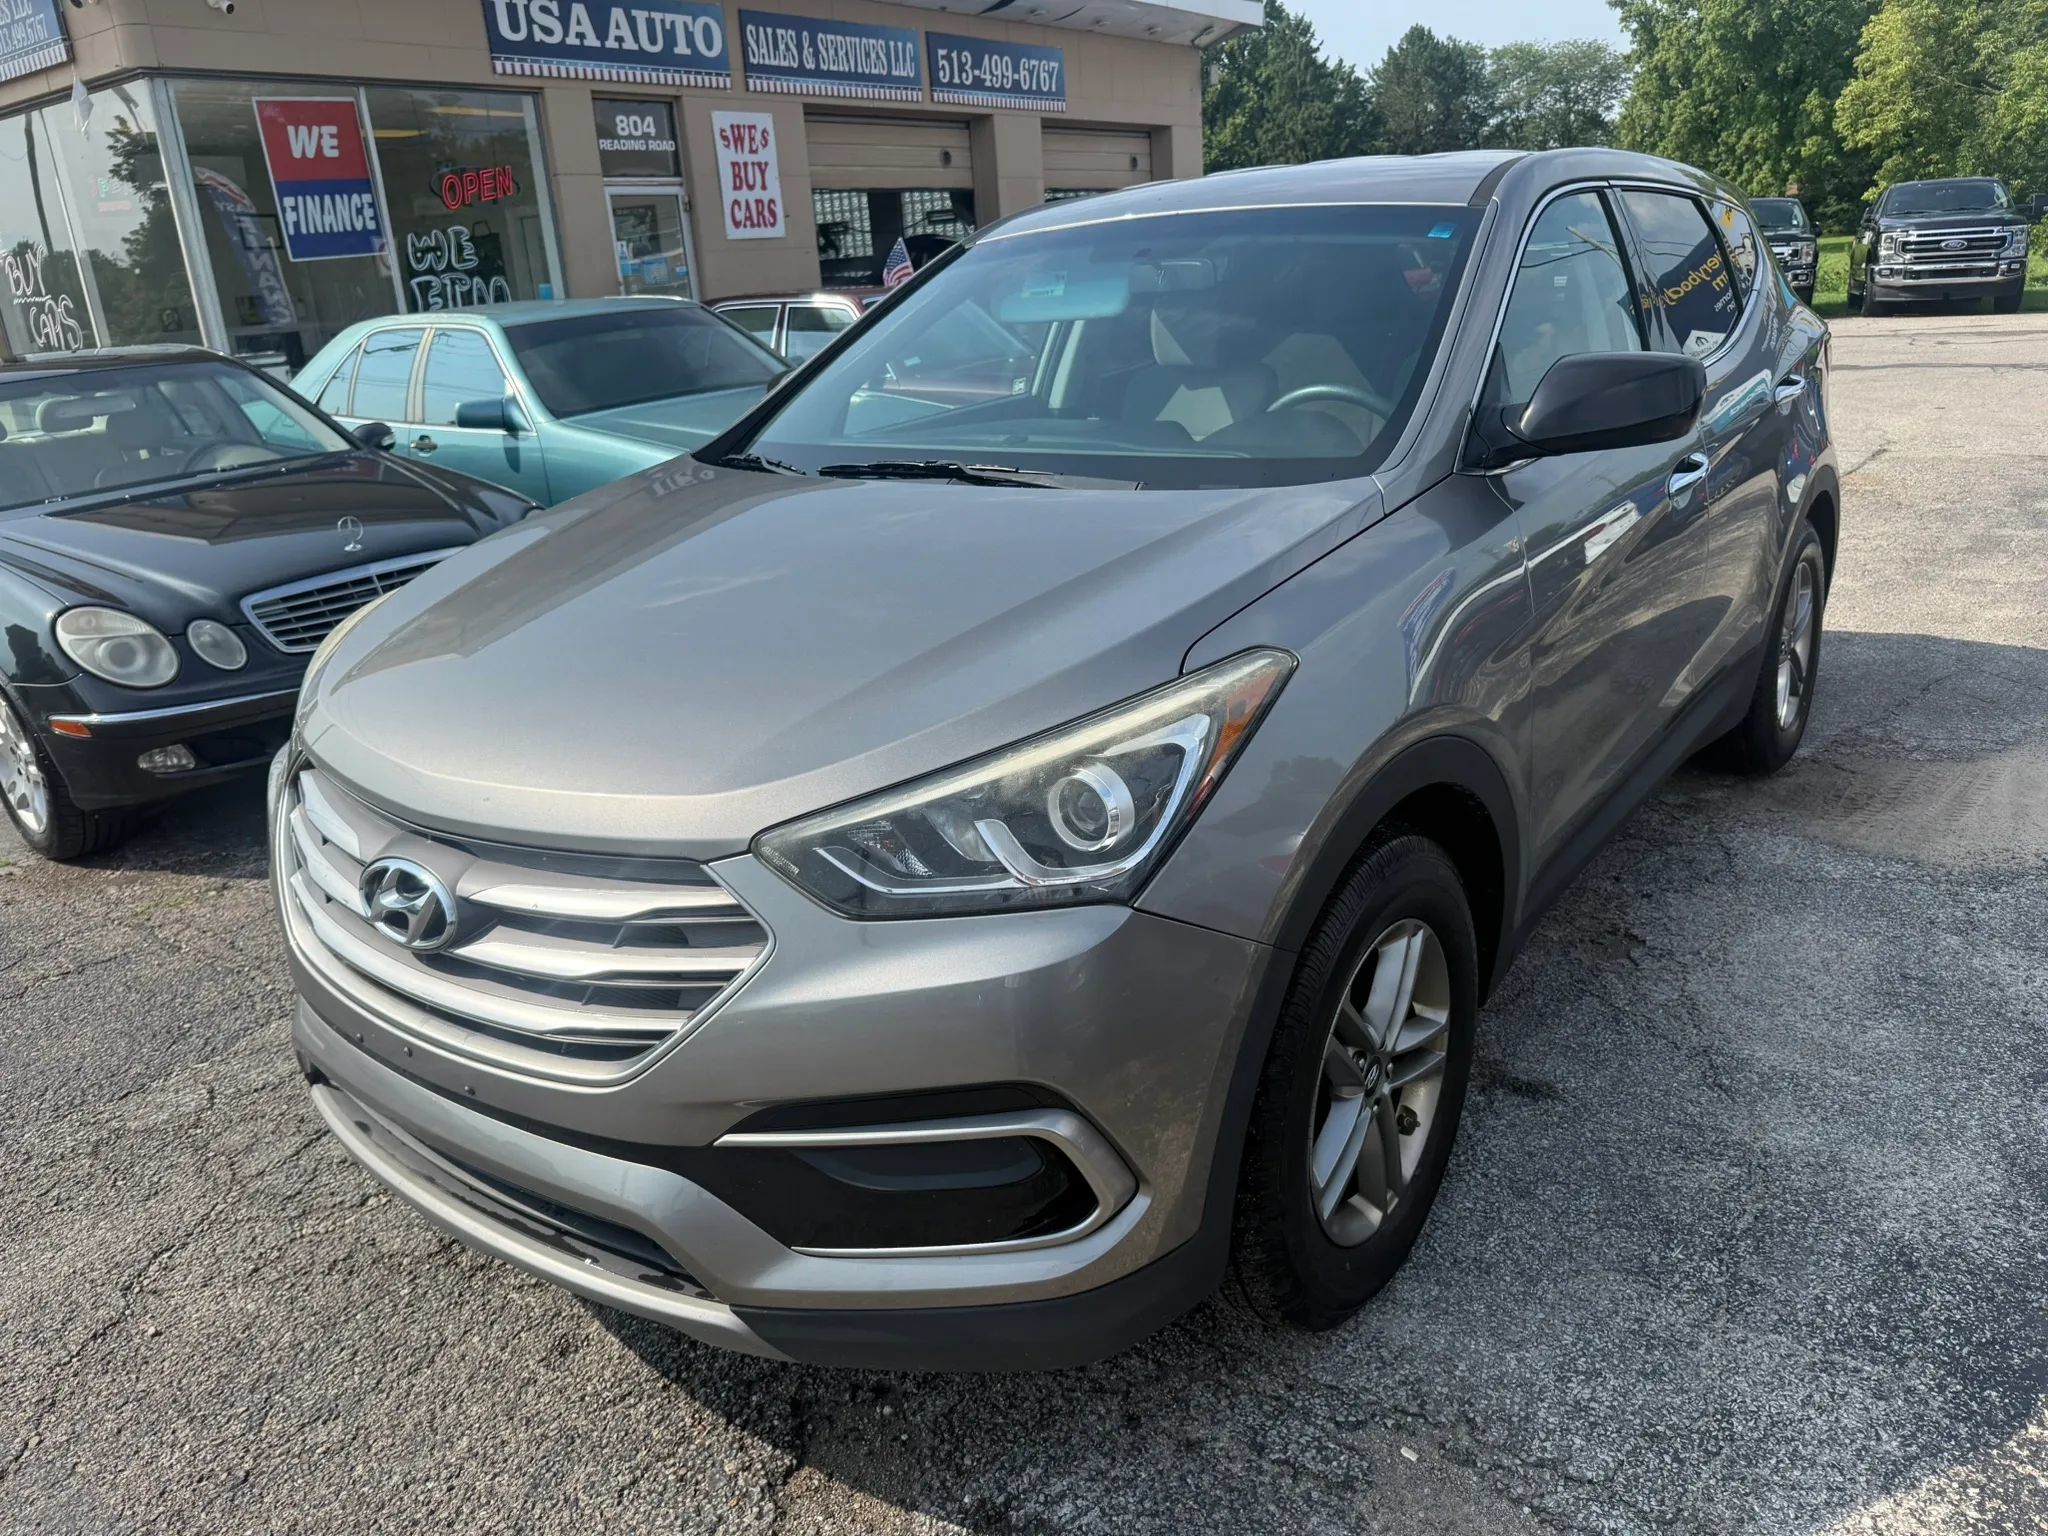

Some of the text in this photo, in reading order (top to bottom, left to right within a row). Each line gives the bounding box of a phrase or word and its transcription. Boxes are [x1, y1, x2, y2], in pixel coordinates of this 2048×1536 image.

[0, 13, 48, 55] 13.499.6767
[494, 0, 723, 58] USA AUTO
[746, 24, 915, 78] SALES & SERVICES LLC
[937, 48, 1059, 92] 513-499-6767
[287, 125, 339, 159] WE
[599, 138, 676, 151] READING ROAD
[615, 114, 656, 136] 804
[442, 165, 513, 209] OPEN
[730, 161, 769, 191] BUY
[282, 193, 377, 236] FINANCE
[730, 198, 778, 229] CARS
[407, 225, 480, 271] WE
[4, 245, 46, 296] BUY
[29, 294, 83, 350] CARS
